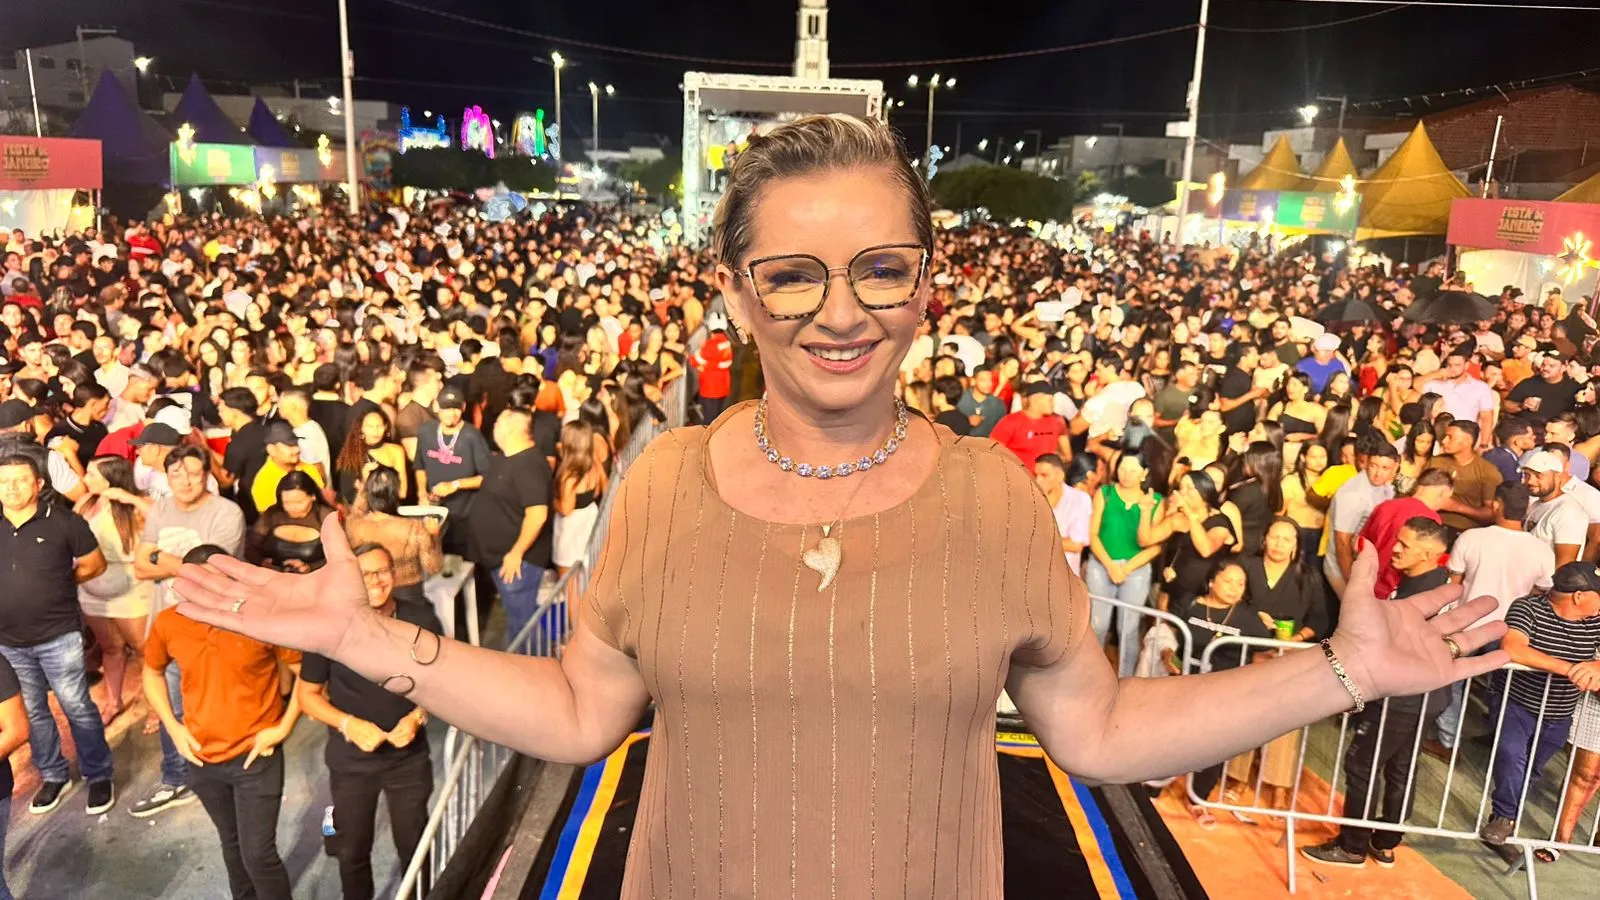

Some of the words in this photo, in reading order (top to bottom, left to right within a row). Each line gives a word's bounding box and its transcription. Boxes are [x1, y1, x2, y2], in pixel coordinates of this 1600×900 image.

[3, 155, 49, 170] JANEIRO
[1503, 206, 1532, 219] FESTA
[1498, 218, 1544, 233] JANEIRO
